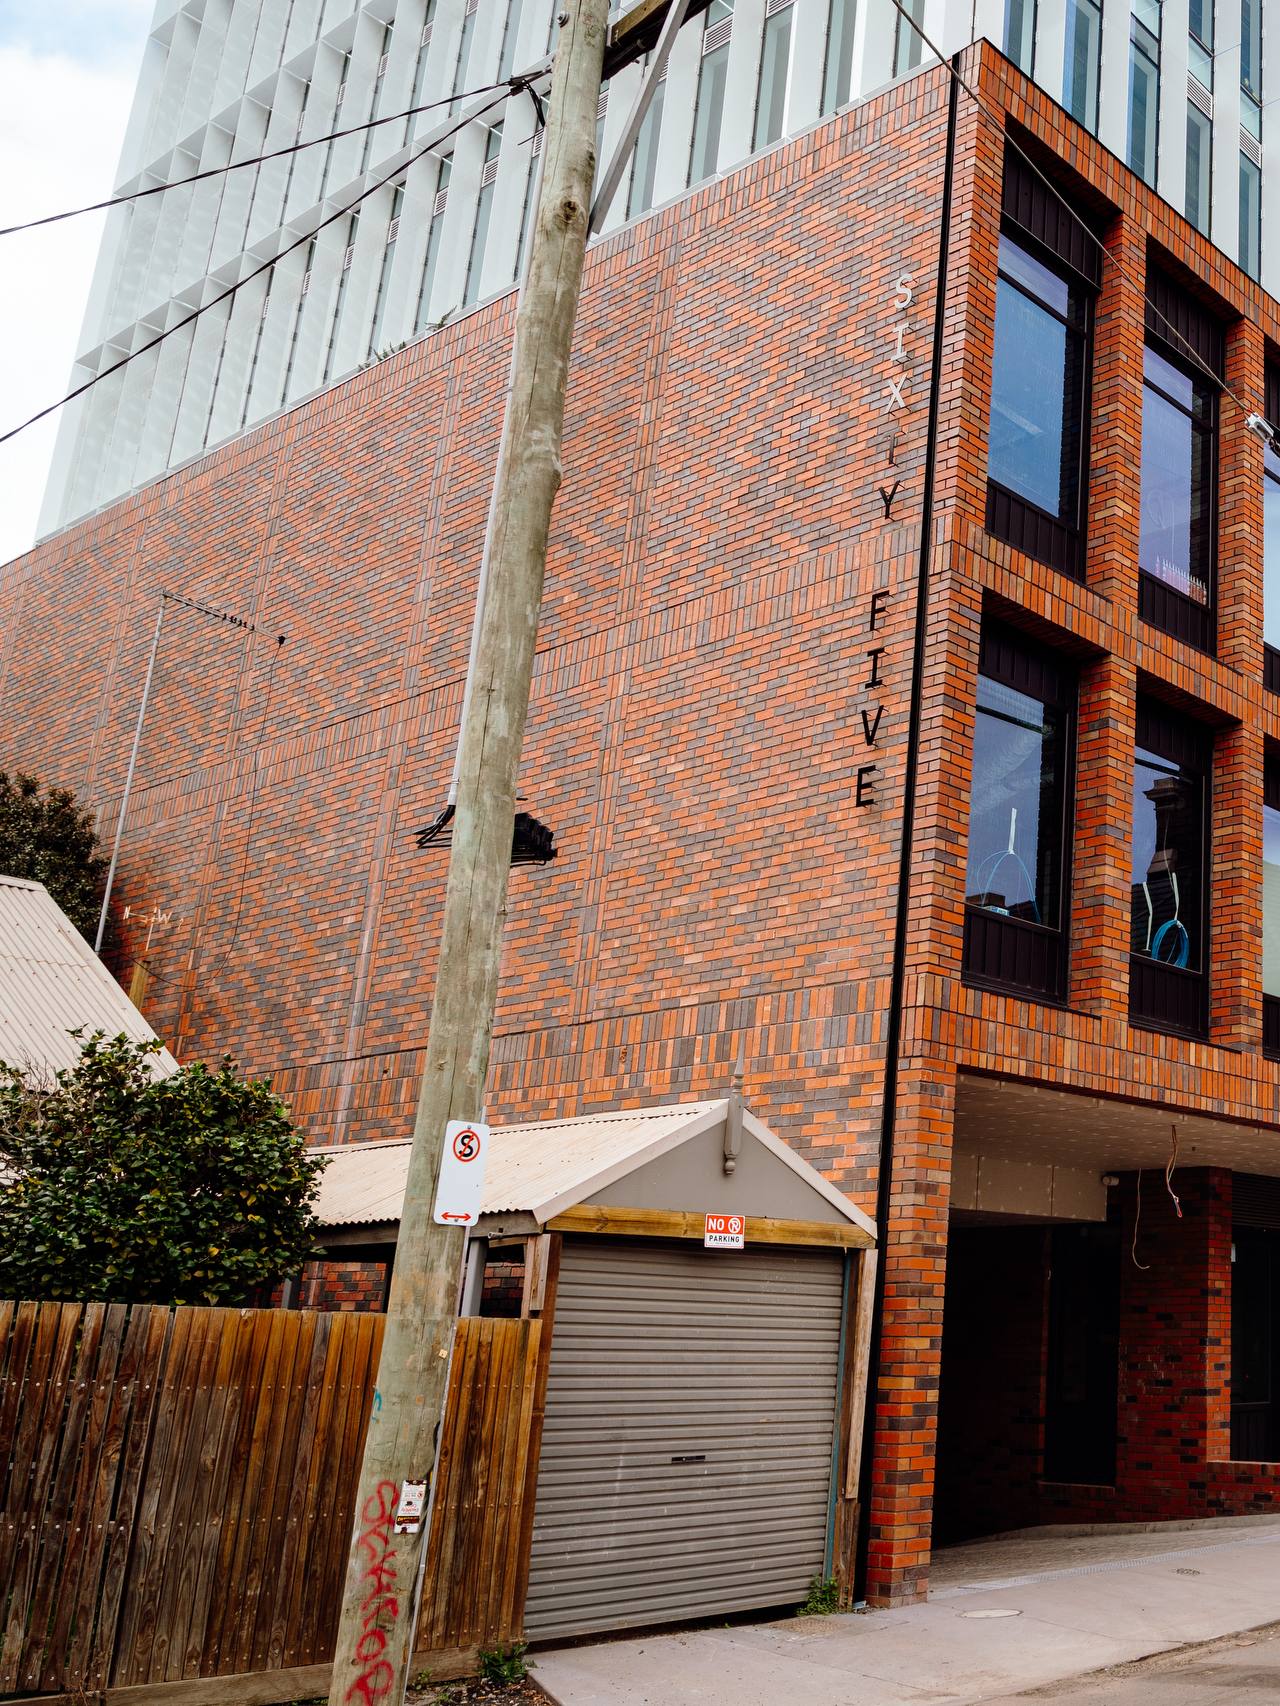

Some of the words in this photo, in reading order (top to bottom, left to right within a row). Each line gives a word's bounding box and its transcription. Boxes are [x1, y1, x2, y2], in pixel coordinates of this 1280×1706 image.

[855, 590, 890, 807] FIVE
[708, 1218, 725, 1231] NO
[708, 1234, 740, 1242] PARKING
